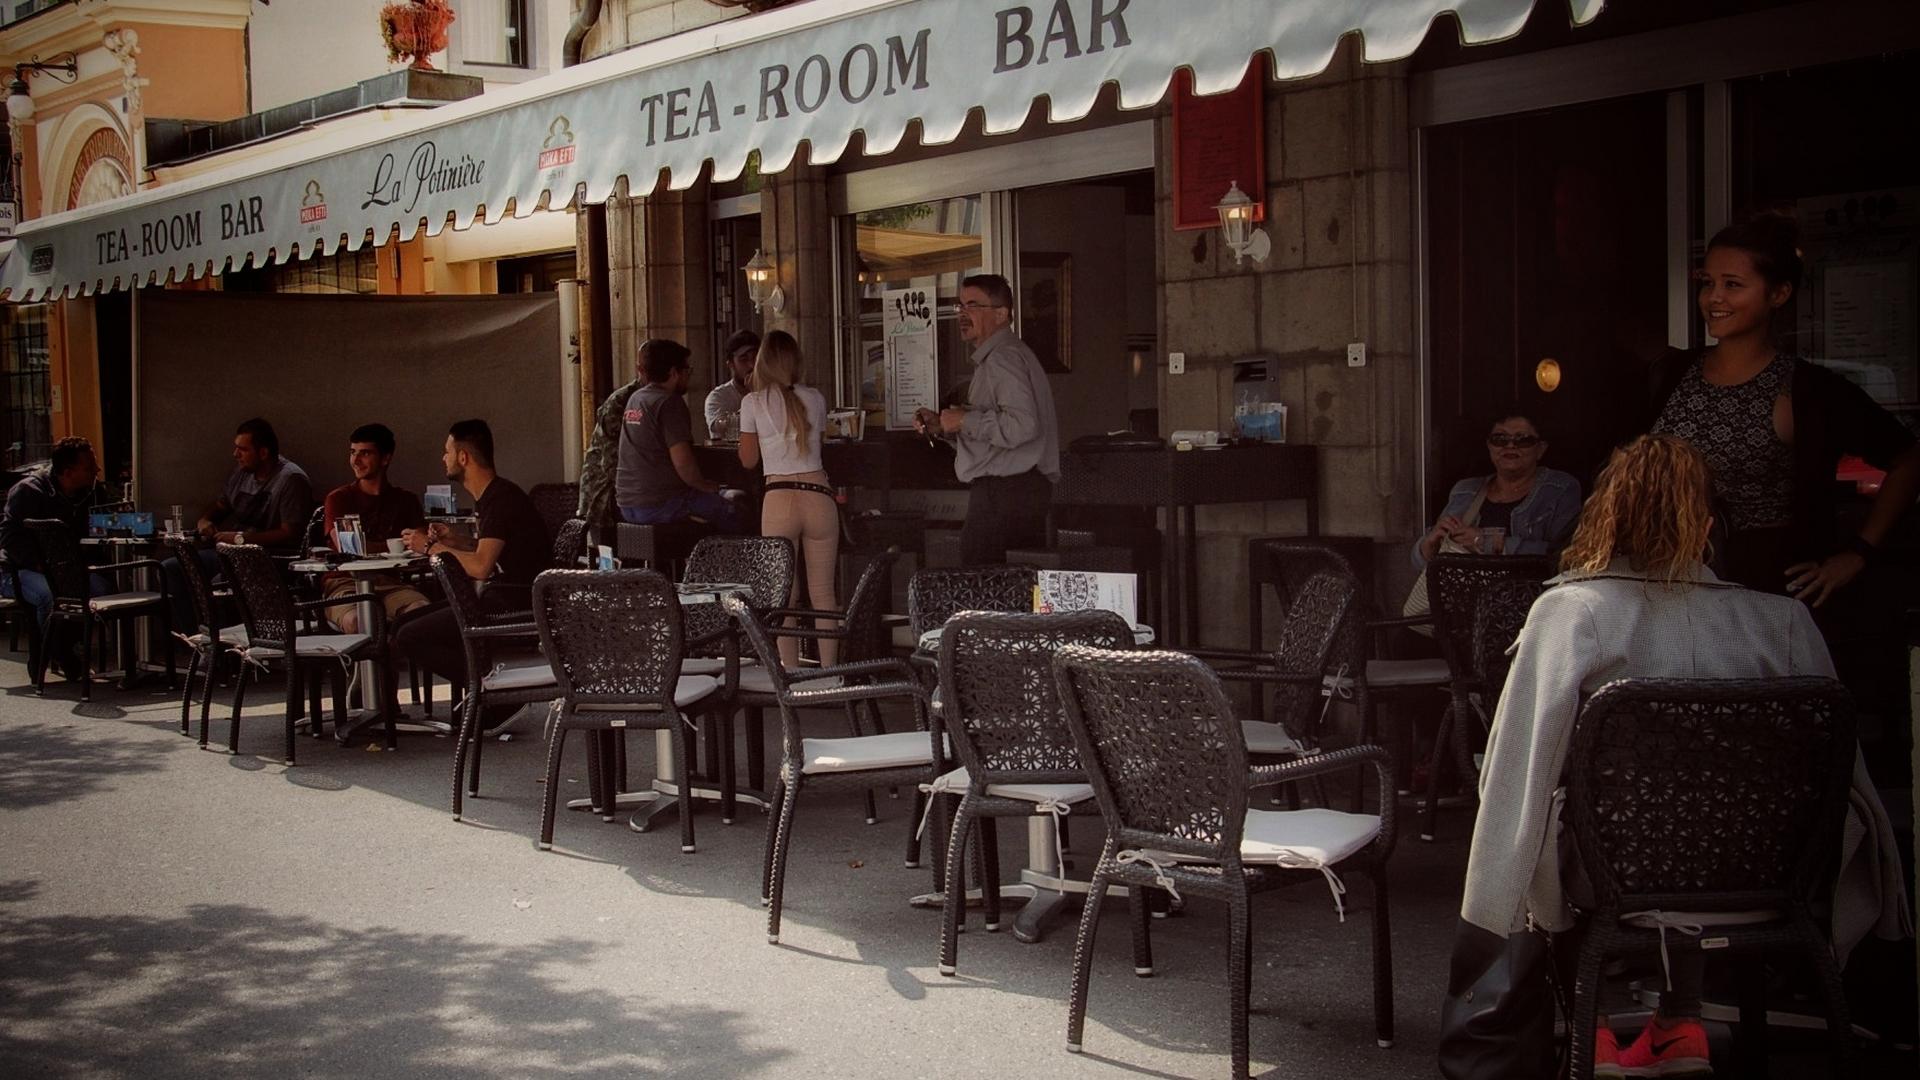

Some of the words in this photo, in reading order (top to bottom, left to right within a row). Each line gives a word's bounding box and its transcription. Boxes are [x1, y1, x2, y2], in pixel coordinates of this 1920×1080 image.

[640, 28, 931, 147] TEA-ROOM
[993, 0, 1132, 74] BAR
[361, 153, 401, 210] La
[403, 140, 485, 213] Potinière
[96, 210, 202, 265] TEA-ROOM
[221, 195, 264, 241] BAR
